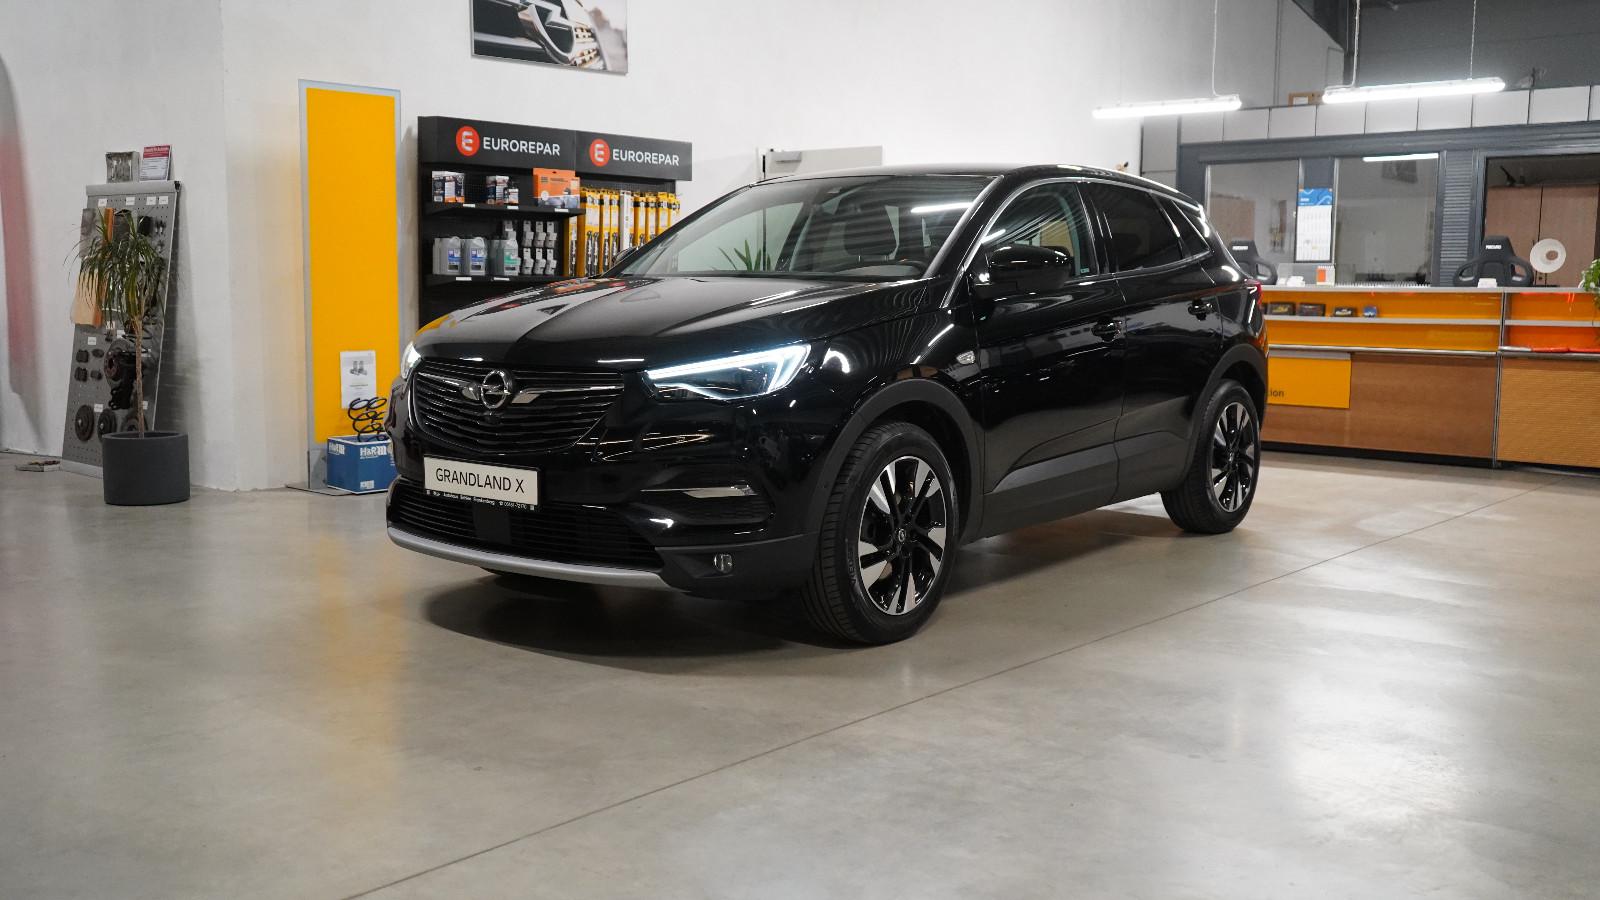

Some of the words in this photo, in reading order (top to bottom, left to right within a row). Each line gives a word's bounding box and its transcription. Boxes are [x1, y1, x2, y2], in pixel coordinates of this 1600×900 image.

[483, 136, 561, 156] EUROREPAR
[612, 148, 680, 167] EUROREPAR
[1270, 387, 1284, 398] ion
[435, 467, 512, 491] GRANDLAND
[515, 478, 525, 494] X
